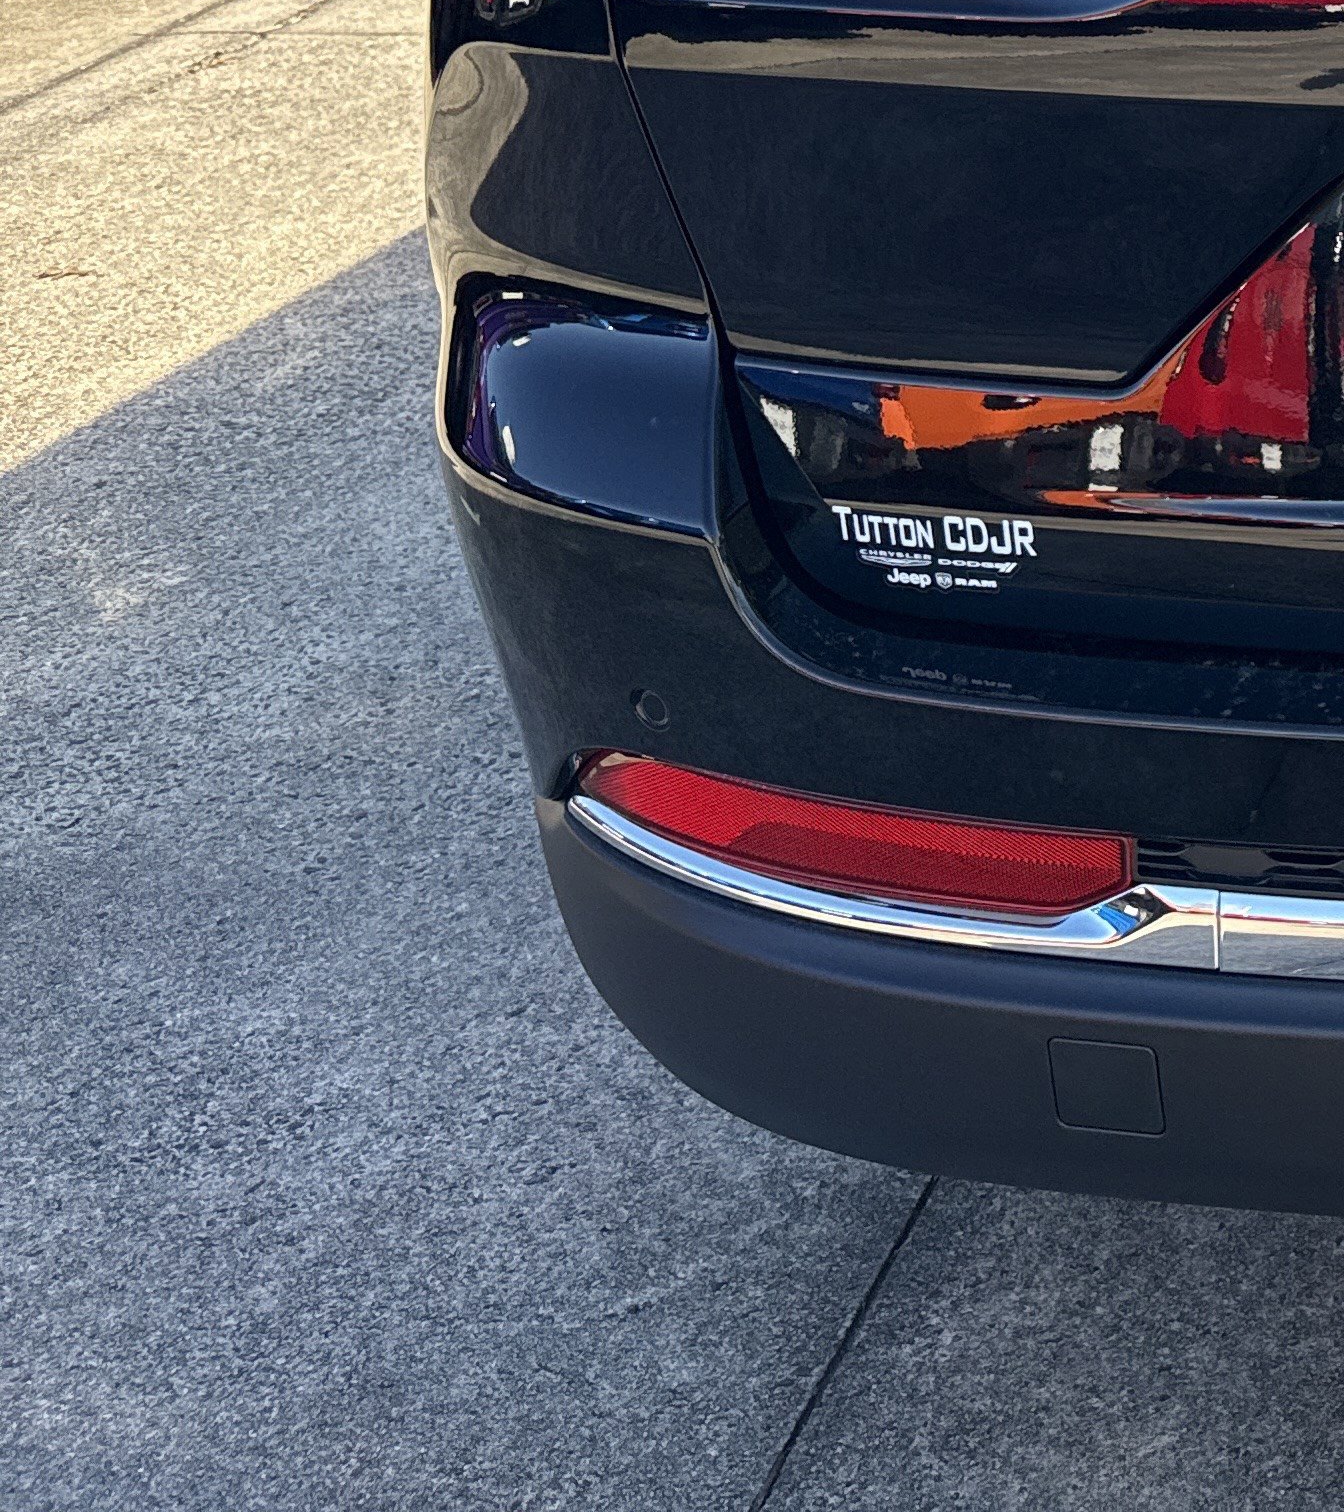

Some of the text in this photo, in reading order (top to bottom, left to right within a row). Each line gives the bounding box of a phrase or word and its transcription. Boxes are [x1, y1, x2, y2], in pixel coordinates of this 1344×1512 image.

[831, 504, 1038, 557] TUTTON CDJR
[858, 548, 932, 561] CHRYSLER
[886, 568, 932, 589] Jeep
[954, 577, 998, 589] RAM
